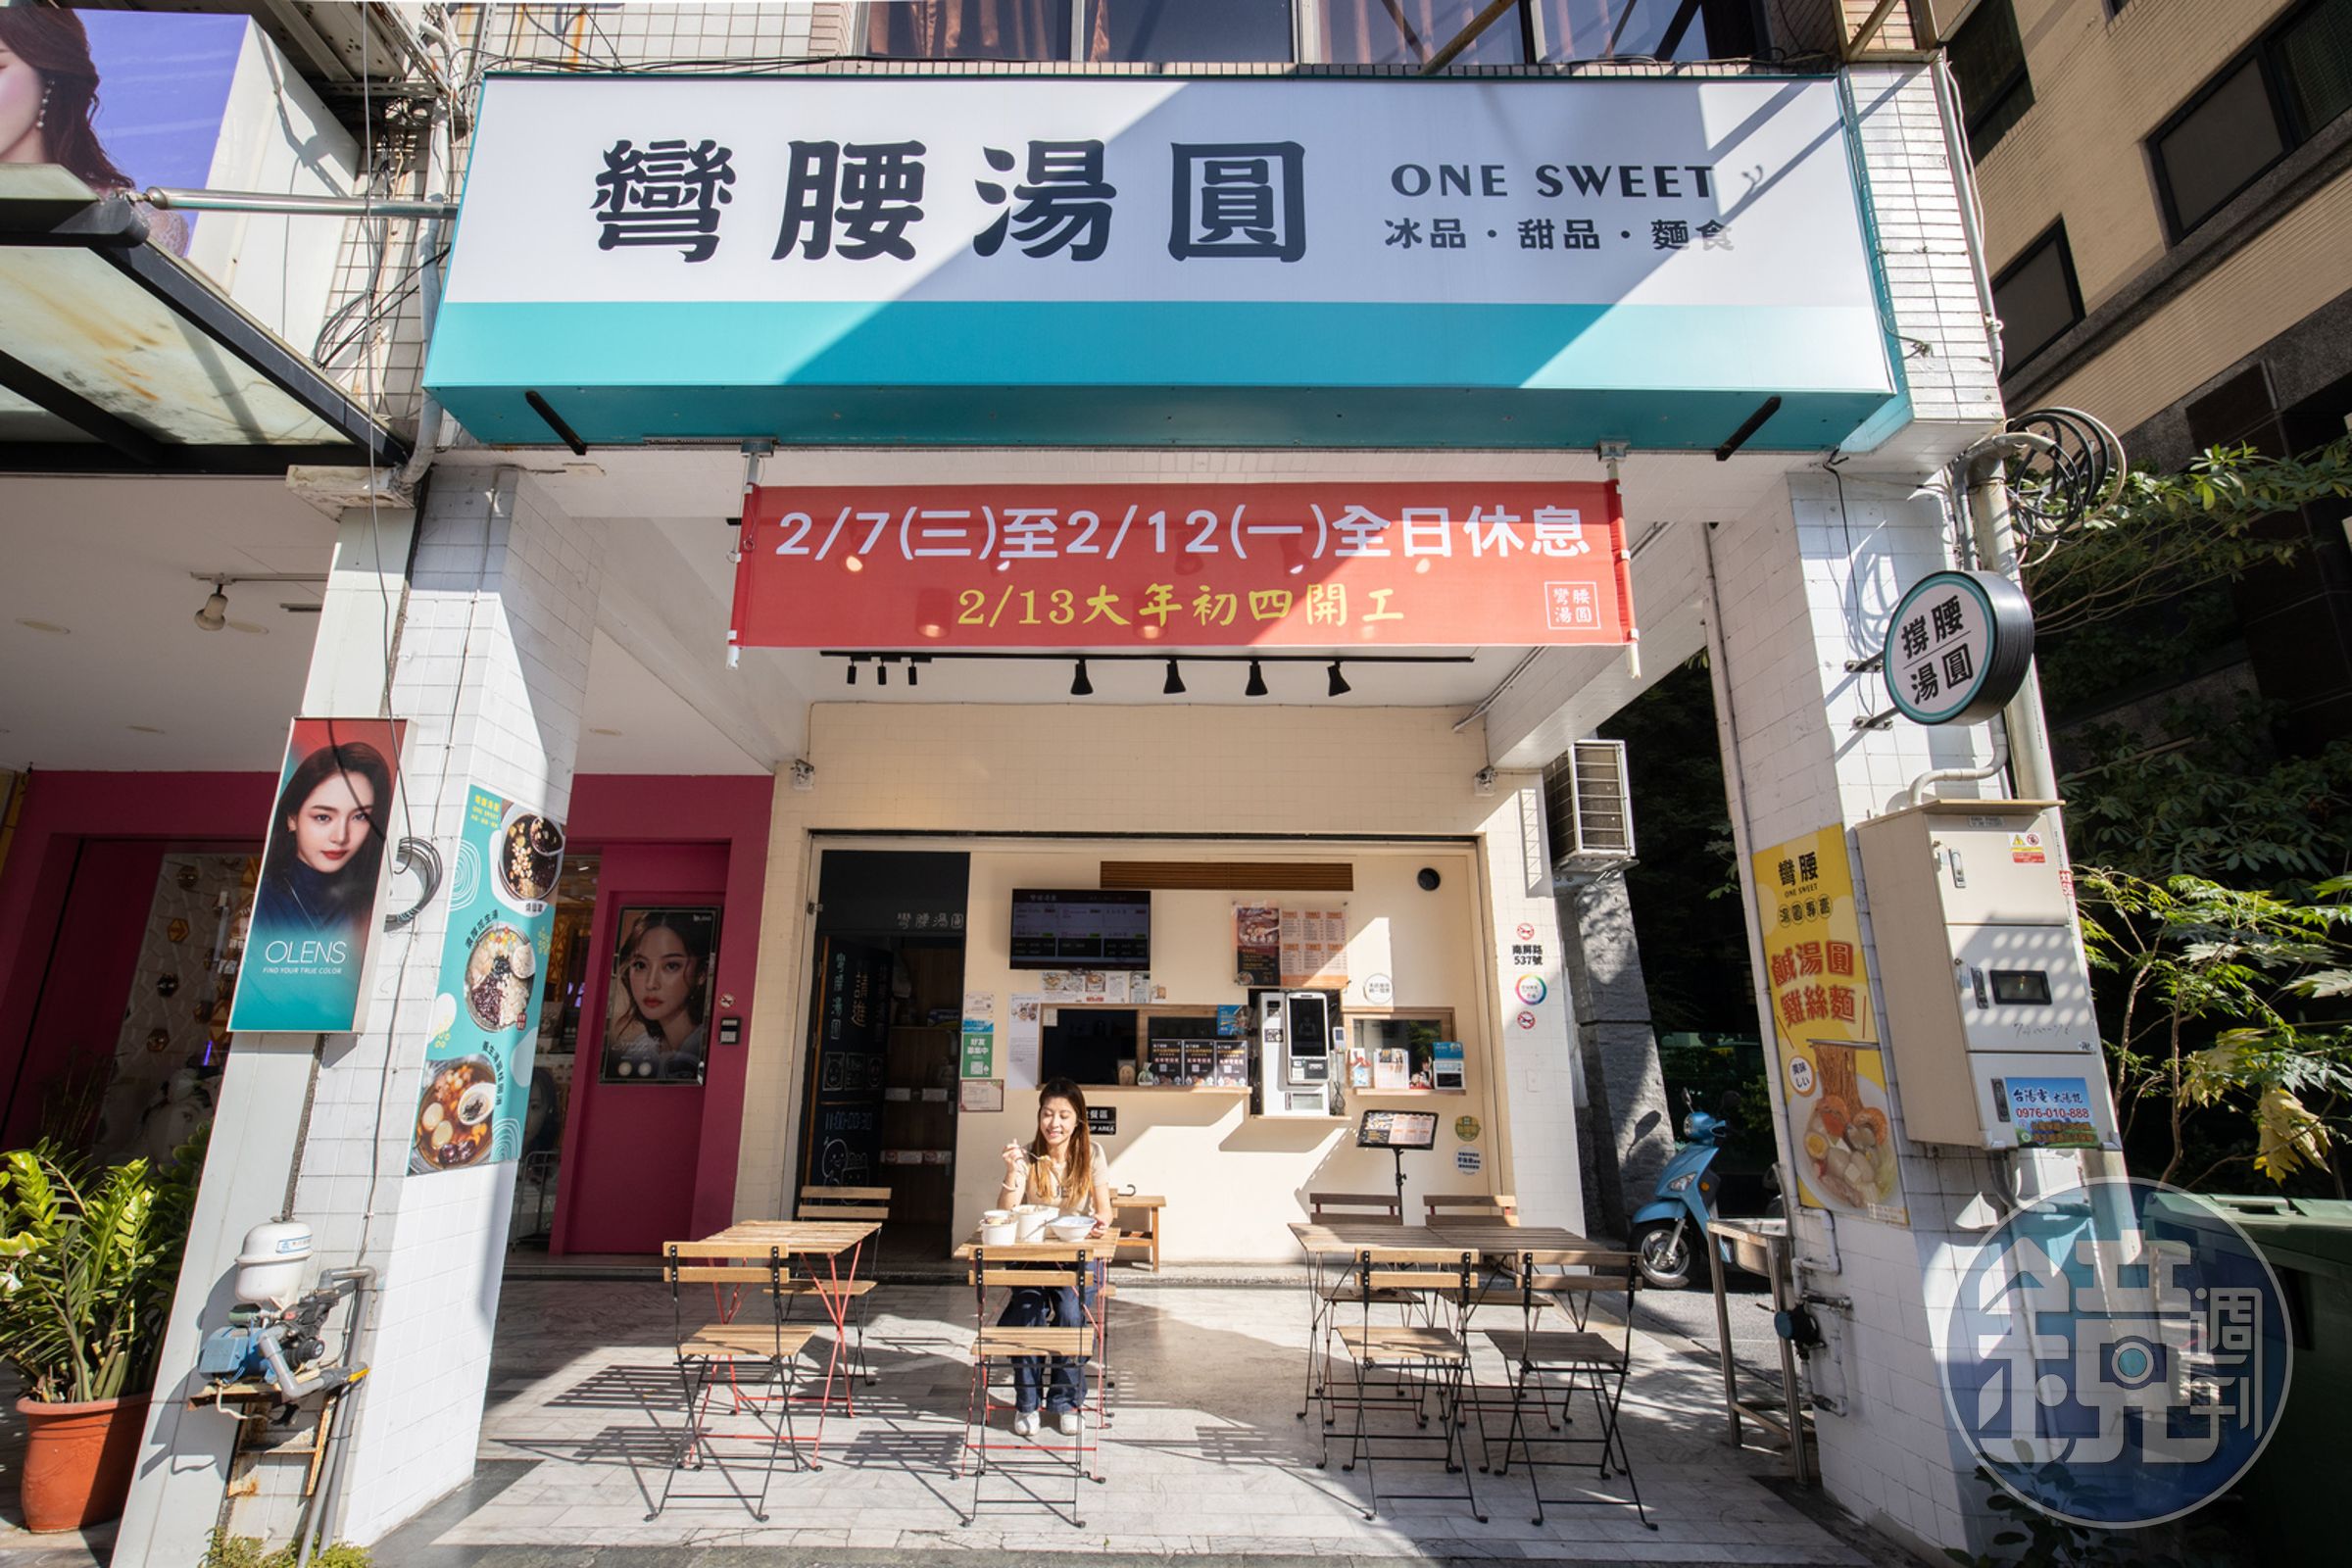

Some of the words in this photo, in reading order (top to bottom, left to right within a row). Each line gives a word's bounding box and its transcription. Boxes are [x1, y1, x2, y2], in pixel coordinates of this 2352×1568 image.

[589, 138, 1306, 264] 彎腰湯圓
[1390, 164, 1508, 197] ONE
[1535, 164, 1715, 198] SWEET
[775, 503, 1592, 562] 2/7(三)至2/12(一)全日休息
[956, 583, 1404, 628] 2/13大年初四開工
[1553, 606, 1593, 624] 湯圓
[1910, 642, 1975, 707] 湯圓
[1778, 851, 1820, 886] 彎腰
[1784, 888, 1797, 899] ONE
[1797, 883, 1819, 896] SWEET
[265, 940, 347, 964] OLENS
[1770, 940, 1855, 988] 鹹湯圓
[1780, 983, 1856, 1030] 雞絲麵
[2015, 1106, 2090, 1119] 0976-010-888
